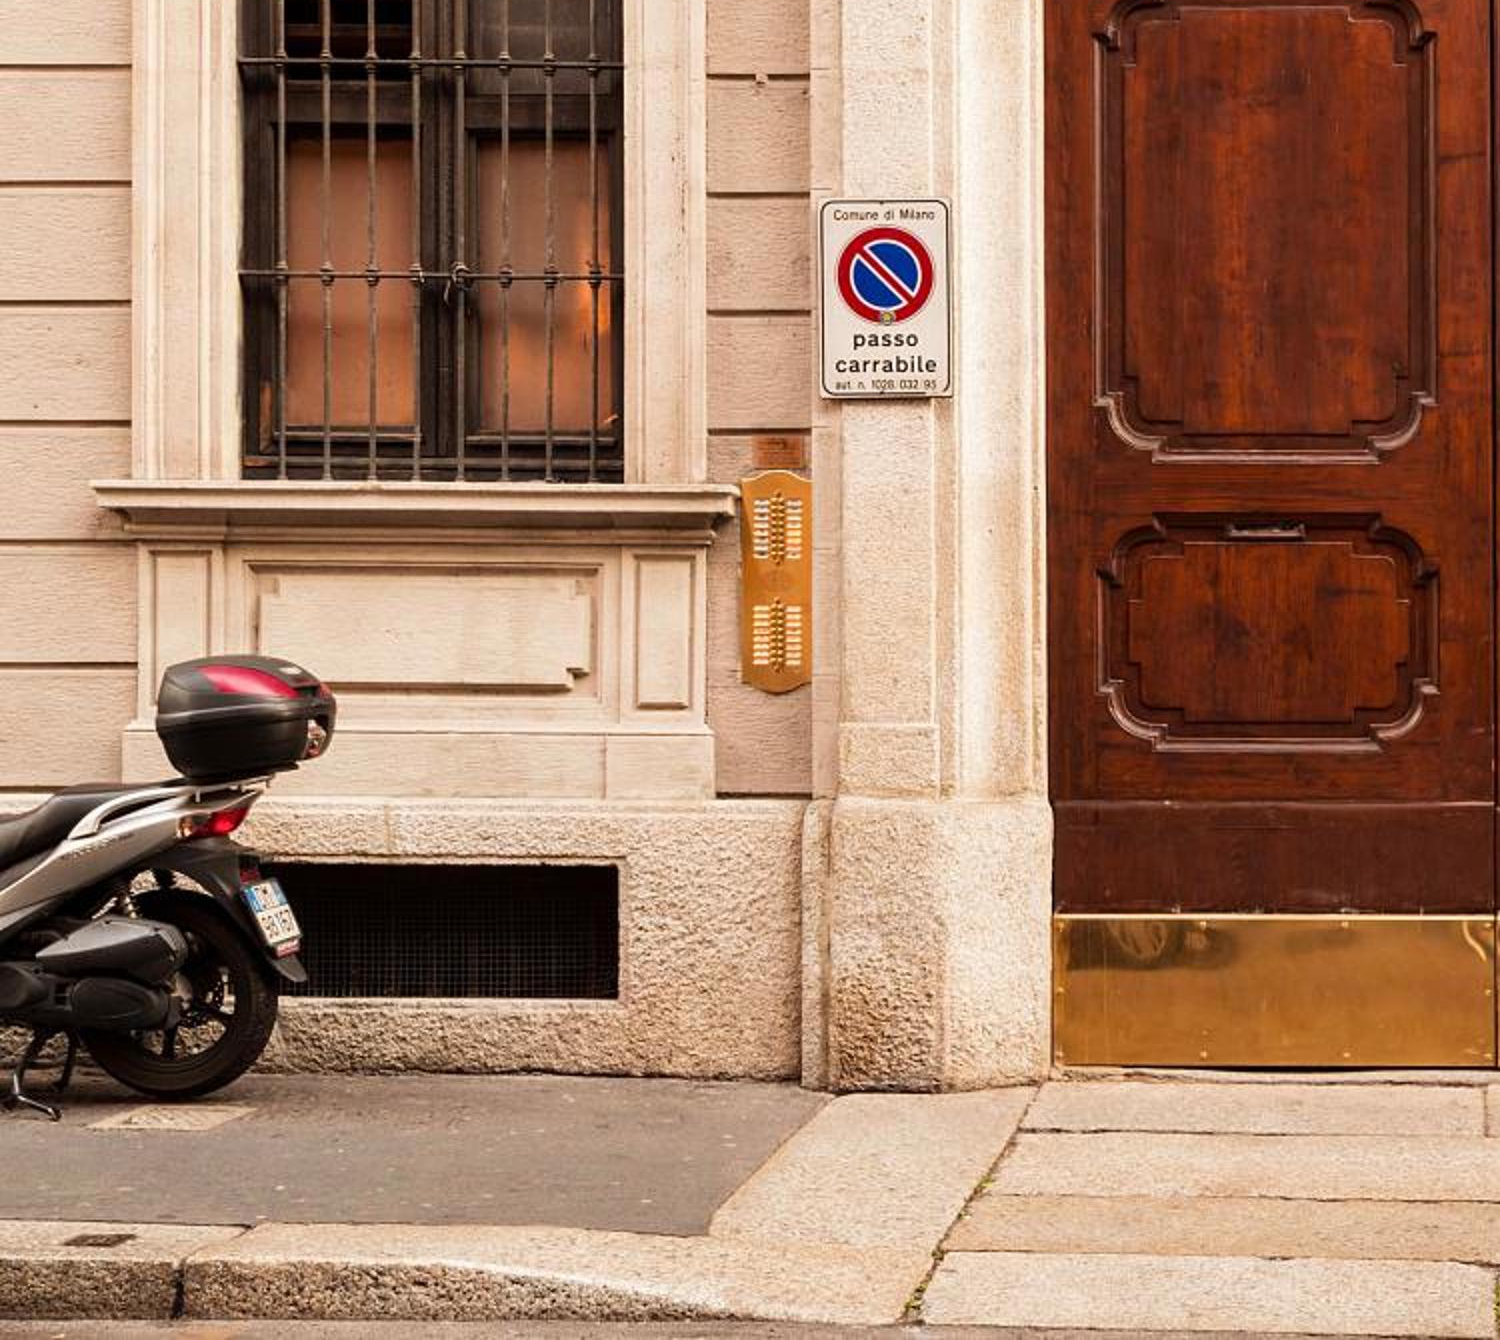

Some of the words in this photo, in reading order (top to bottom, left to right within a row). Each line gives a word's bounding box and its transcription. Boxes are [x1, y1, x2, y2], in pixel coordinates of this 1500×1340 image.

[833, 209, 879, 221] Comune
[883, 209, 895, 221] di
[899, 209, 935, 220] Milano
[853, 332, 919, 350] passo
[835, 356, 937, 373] carrabile
